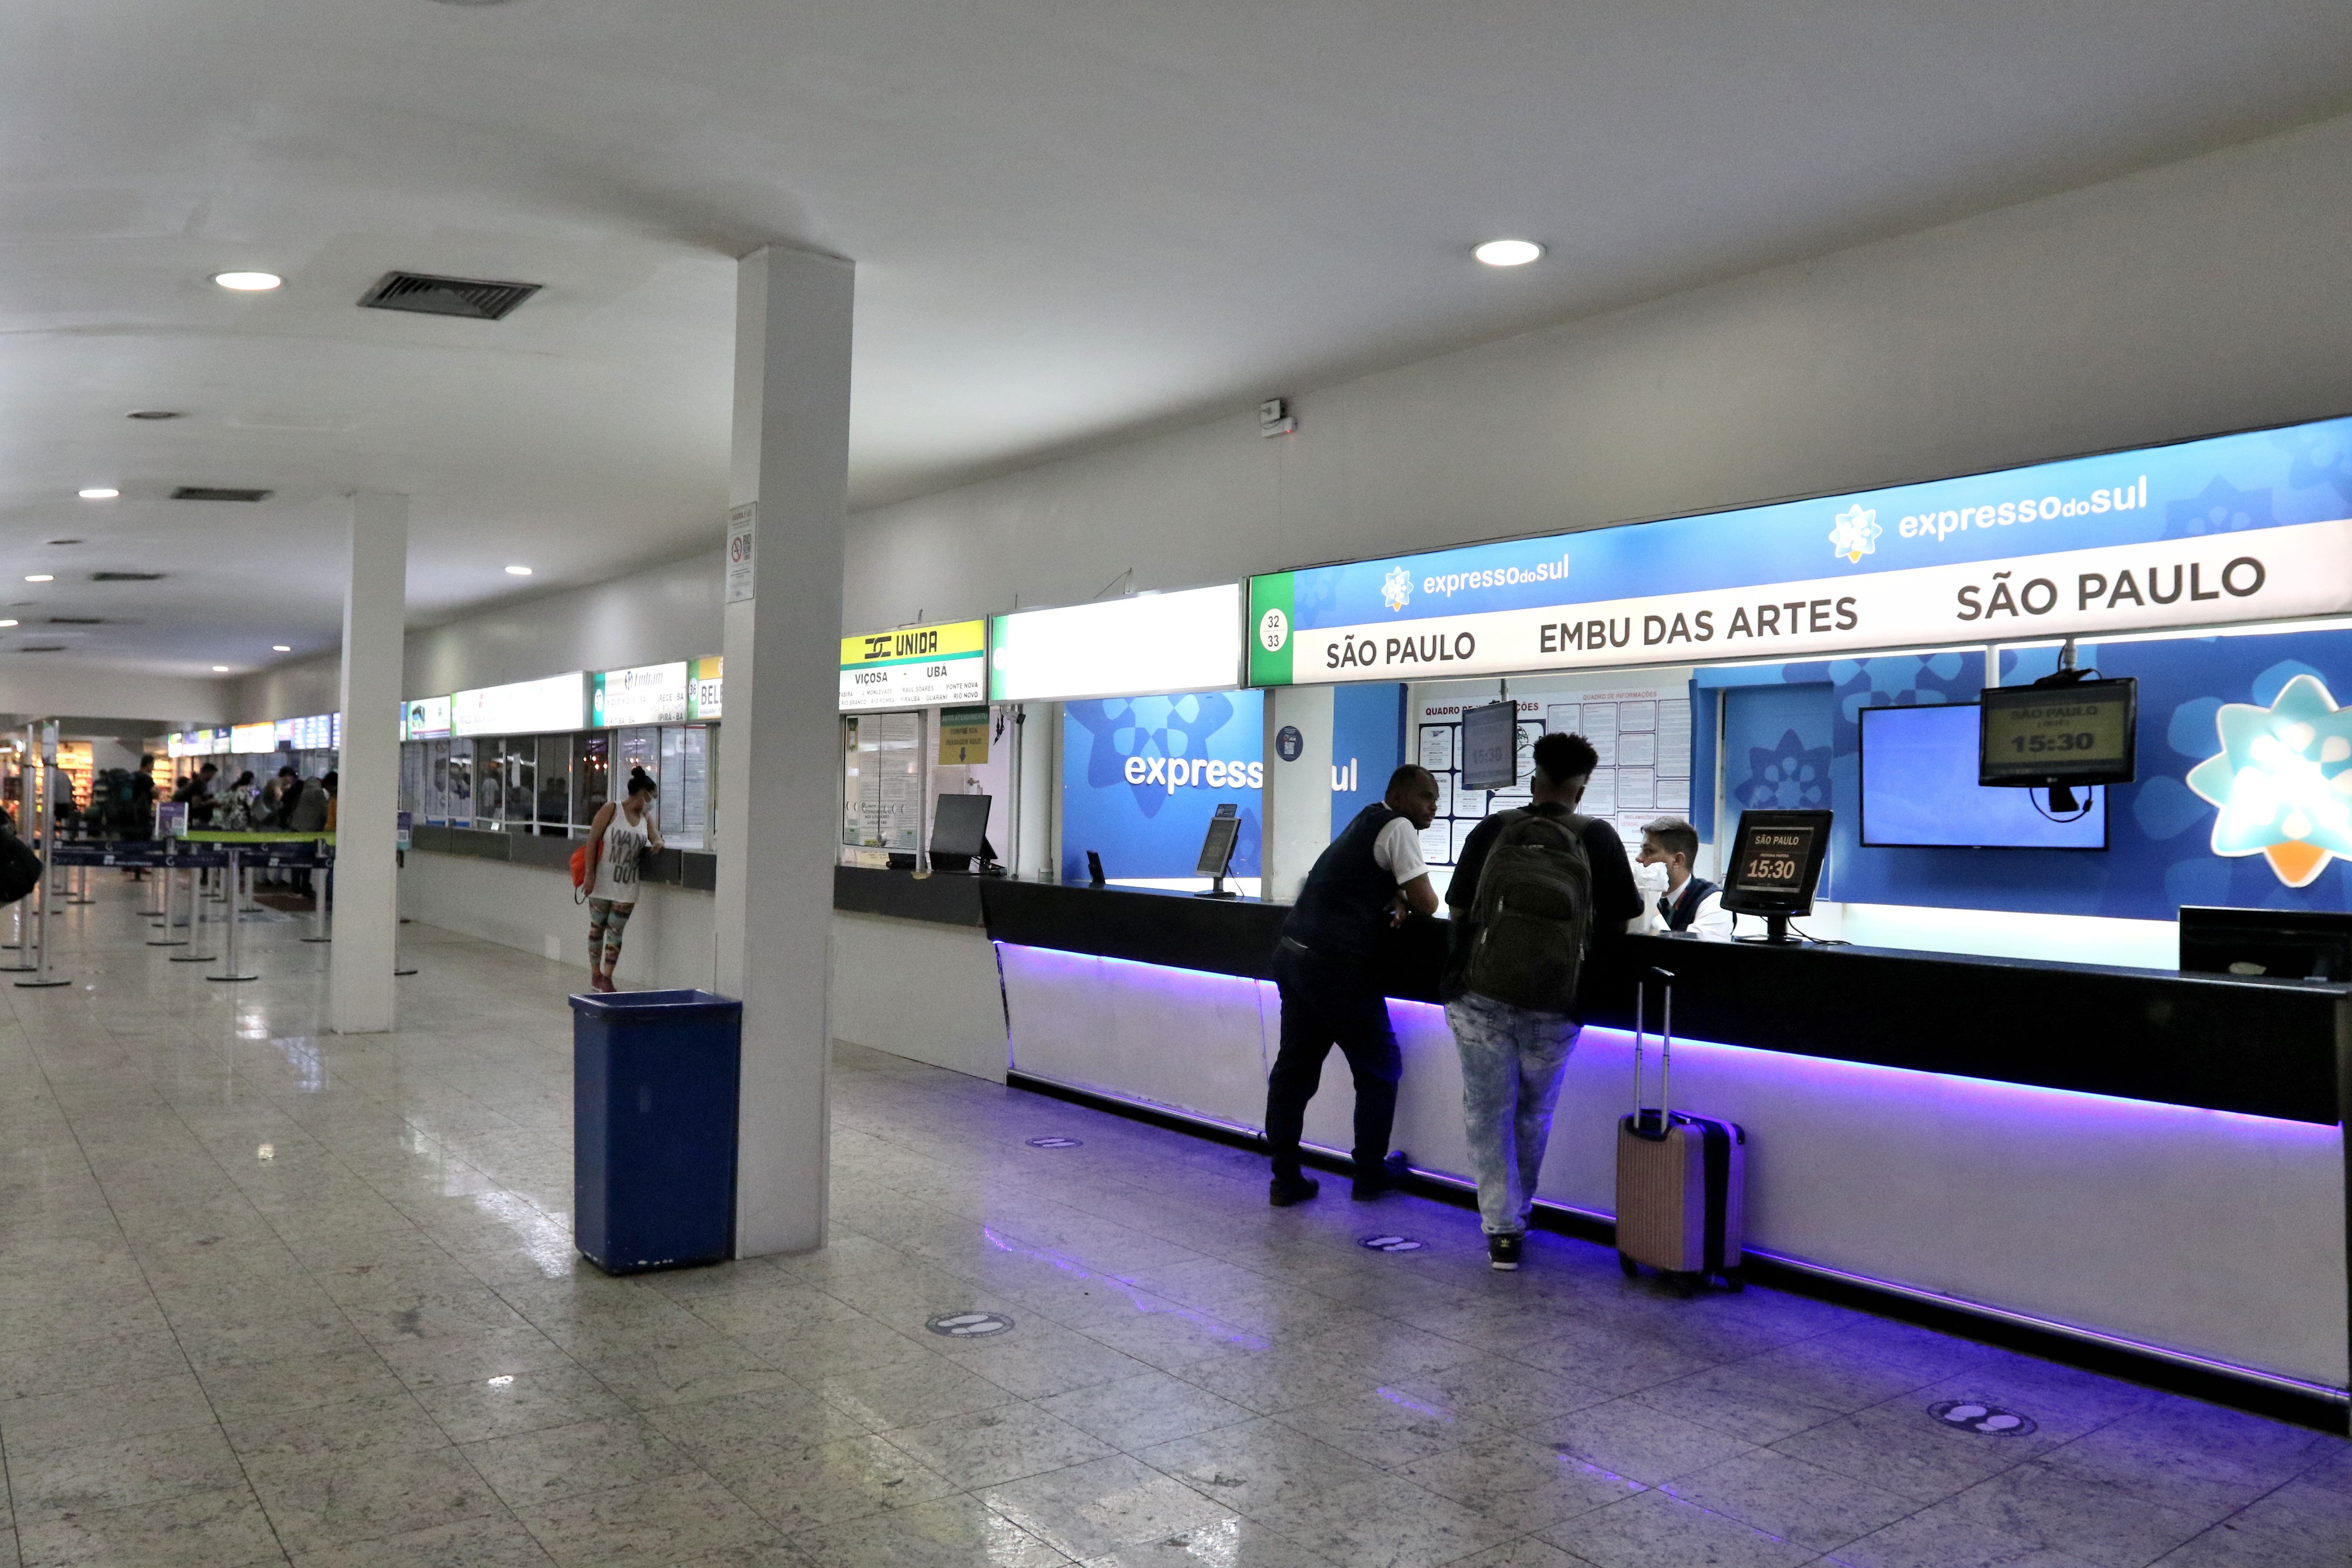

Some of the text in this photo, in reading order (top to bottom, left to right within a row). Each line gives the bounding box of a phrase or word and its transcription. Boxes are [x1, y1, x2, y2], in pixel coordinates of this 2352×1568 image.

[1956, 556, 2266, 622] SÃO PAULO
[1268, 615, 1280, 628] 32
[1540, 597, 1858, 653] EMBU DAS ARTES
[896, 631, 937, 656] UNIDA
[1268, 635, 1279, 647] 33
[1326, 631, 1476, 669] SÃO PAULO
[855, 672, 888, 686] VIÇOSA
[927, 663, 947, 677] UBÁ
[677, 692, 683, 701] BA
[689, 684, 696, 695] 36
[596, 695, 601, 705] 37
[658, 713, 671, 721] IPIRÁ
[676, 712, 683, 720] BA
[1426, 707, 1459, 716] QUADRO
[2011, 732, 2095, 753] 15:30
[1755, 834, 1799, 845] SÃO PAULO
[613, 865, 637, 884] OUT
[1747, 859, 1795, 879] 15:30
